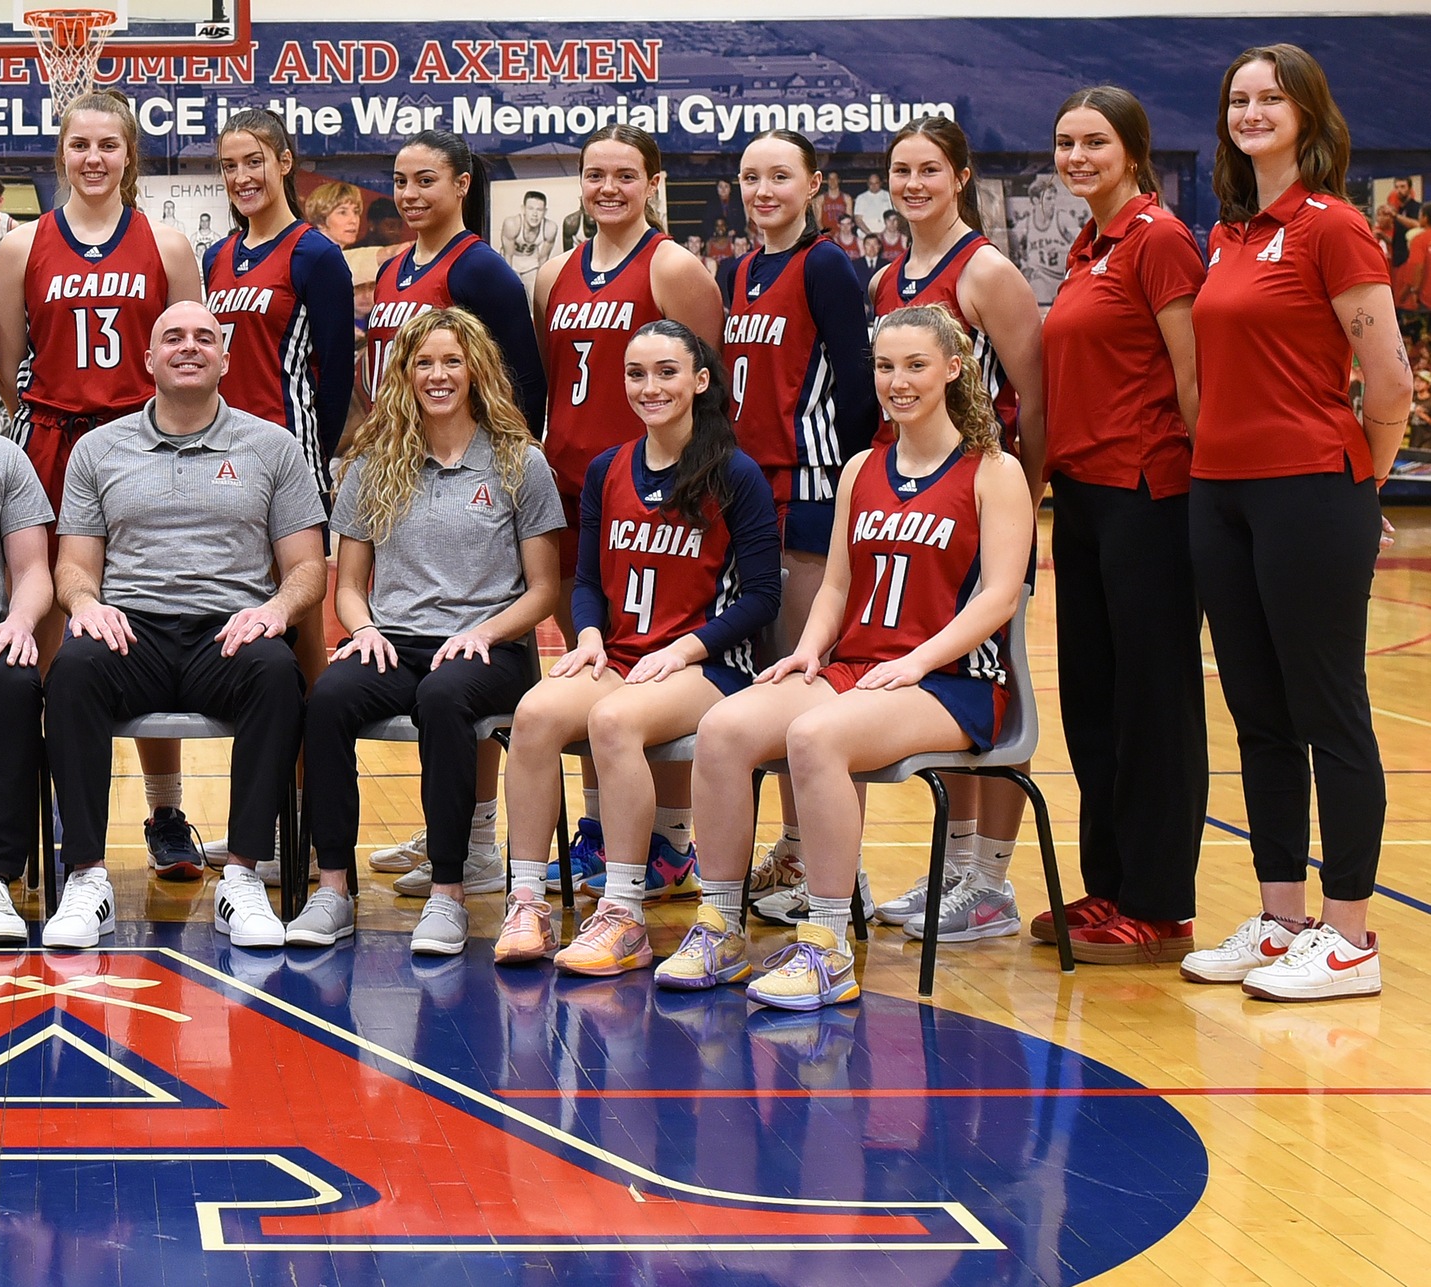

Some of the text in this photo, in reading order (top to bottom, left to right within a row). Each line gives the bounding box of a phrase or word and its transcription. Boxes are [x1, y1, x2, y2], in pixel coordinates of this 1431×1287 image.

[198, 26, 231, 38] AUS
[270, 41, 399, 84] AND
[410, 39, 662, 83] AXEMEN
[217, 97, 253, 135] i
[351, 96, 442, 135] War
[453, 95, 668, 135] Memorial
[678, 95, 955, 141] Gymnasium
[44, 272, 146, 303] ACADIA
[72, 307, 121, 369] 13
[368, 301, 433, 330] CADI
[549, 301, 635, 332] ACADIA
[572, 341, 594, 406] 3
[732, 355, 748, 422] 9
[608, 518, 704, 559] ACADIA
[852, 509, 956, 550] ACADIA
[623, 565, 656, 634] 4
[860, 553, 910, 629] 11
